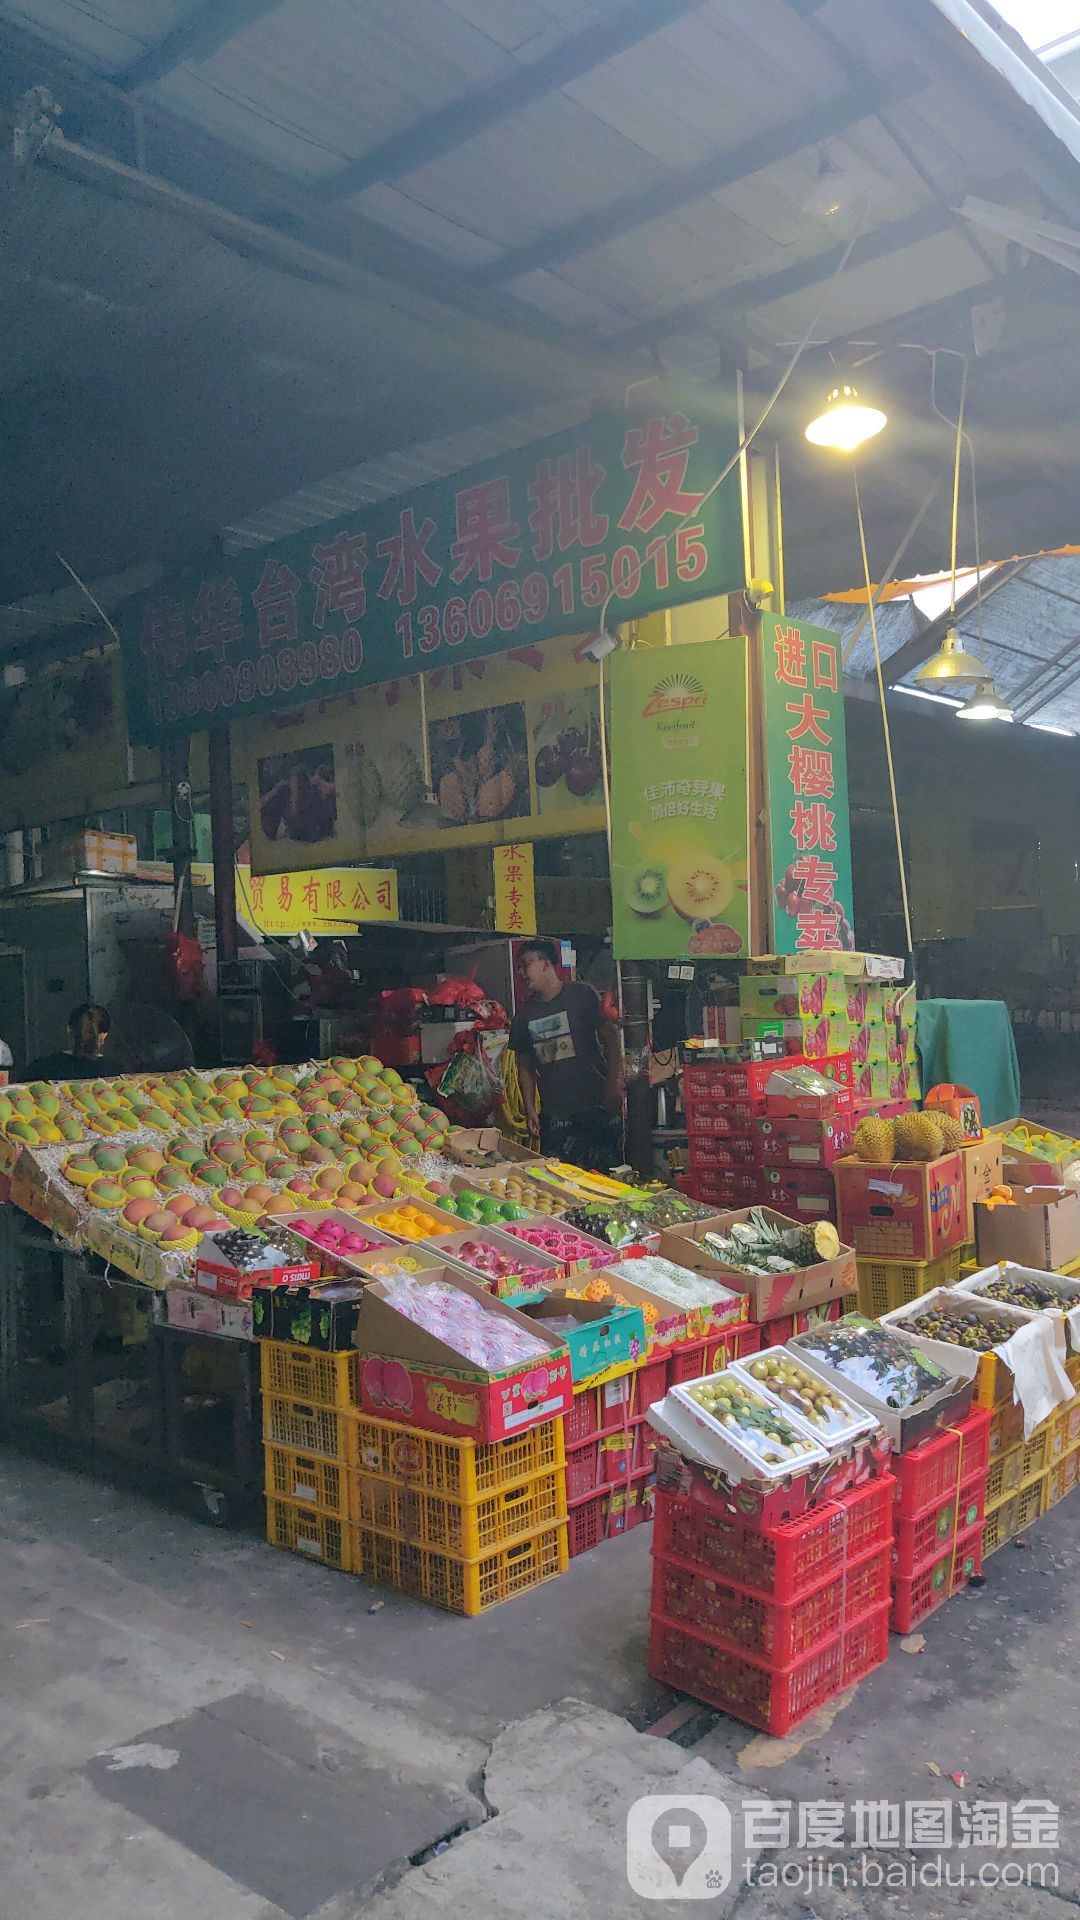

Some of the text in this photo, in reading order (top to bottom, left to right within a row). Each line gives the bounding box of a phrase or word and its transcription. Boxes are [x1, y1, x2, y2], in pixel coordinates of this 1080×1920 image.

[396, 524, 710, 657] 13606915015
[773, 624, 839, 693] 进口
[642, 691, 708, 718] Zespri
[656, 719, 696, 733] Kiwifruit
[643, 778, 727, 803] 佳沛奇异果
[650, 798, 718, 821] 加倍好生活
[502, 845, 526, 930] 水果专卖
